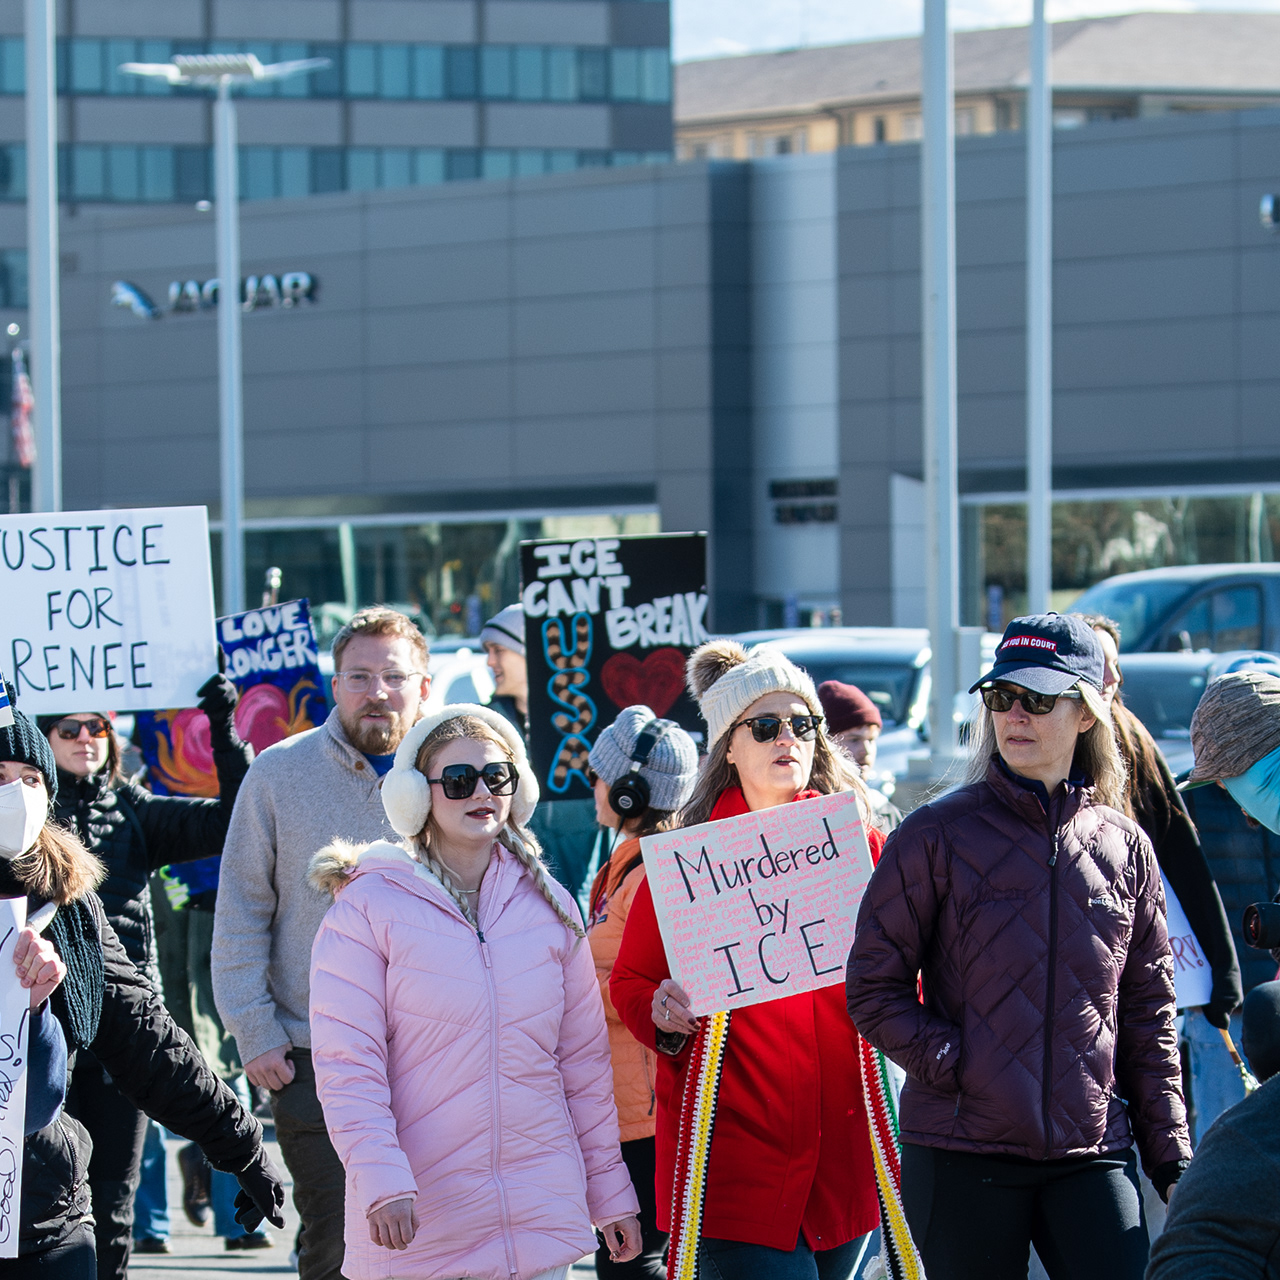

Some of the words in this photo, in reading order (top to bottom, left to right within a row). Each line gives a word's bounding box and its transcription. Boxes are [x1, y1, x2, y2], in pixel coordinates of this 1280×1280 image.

[534, 538, 623, 579] ICE
[48, 588, 123, 630] FOR
[523, 575, 631, 618] CAN'T
[221, 602, 308, 643] LOVE
[605, 591, 709, 649] BREAK
[1021, 637, 1030, 646] IN
[1030, 638, 1056, 650] COURT
[12, 638, 153, 697] RENEE
[542, 612, 598, 794] USA
[674, 817, 840, 903] Murdered
[749, 888, 789, 934] by
[713, 918, 843, 998] ICE
